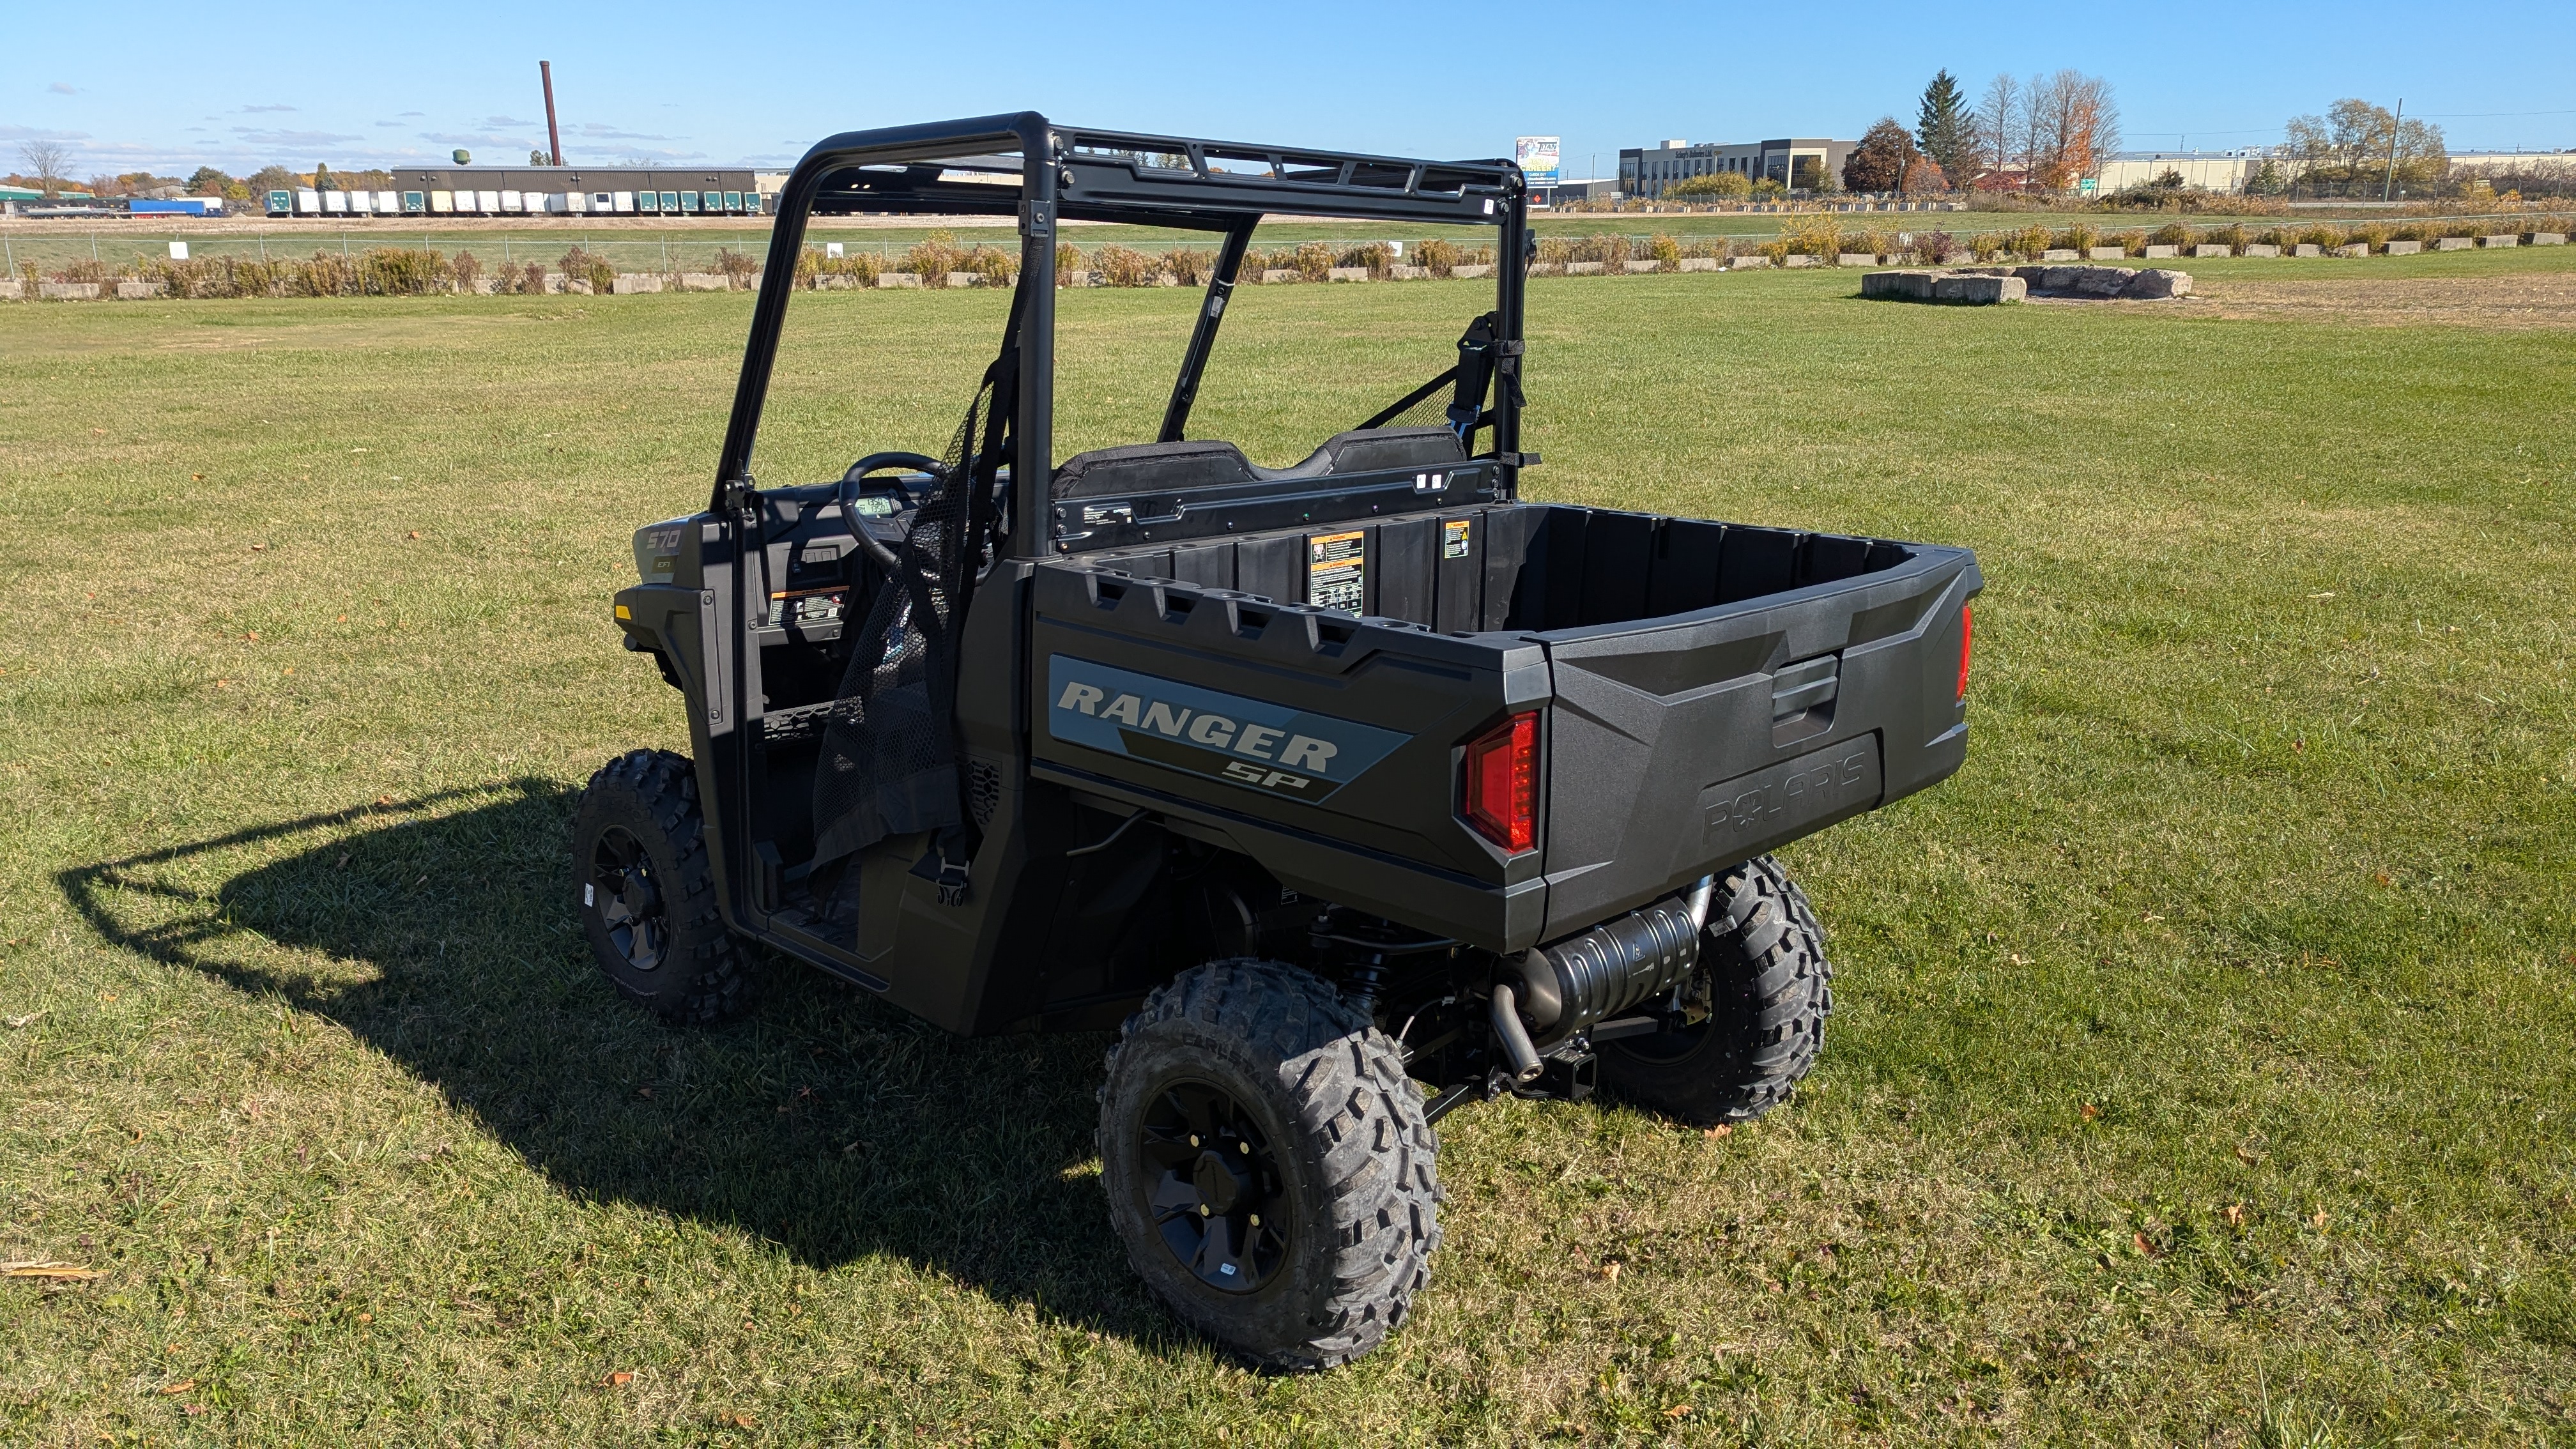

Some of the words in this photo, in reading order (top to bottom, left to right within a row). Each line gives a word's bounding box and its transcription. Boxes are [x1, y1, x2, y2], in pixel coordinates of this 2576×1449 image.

[1537, 141, 1557, 152] TITAN
[647, 530, 681, 549] 570
[1057, 681, 1338, 772] RANGER
[1222, 762, 1310, 788] SP
[1703, 752, 1865, 845] POLARIS
[1182, 1032, 1275, 1100] CARLSTAR
